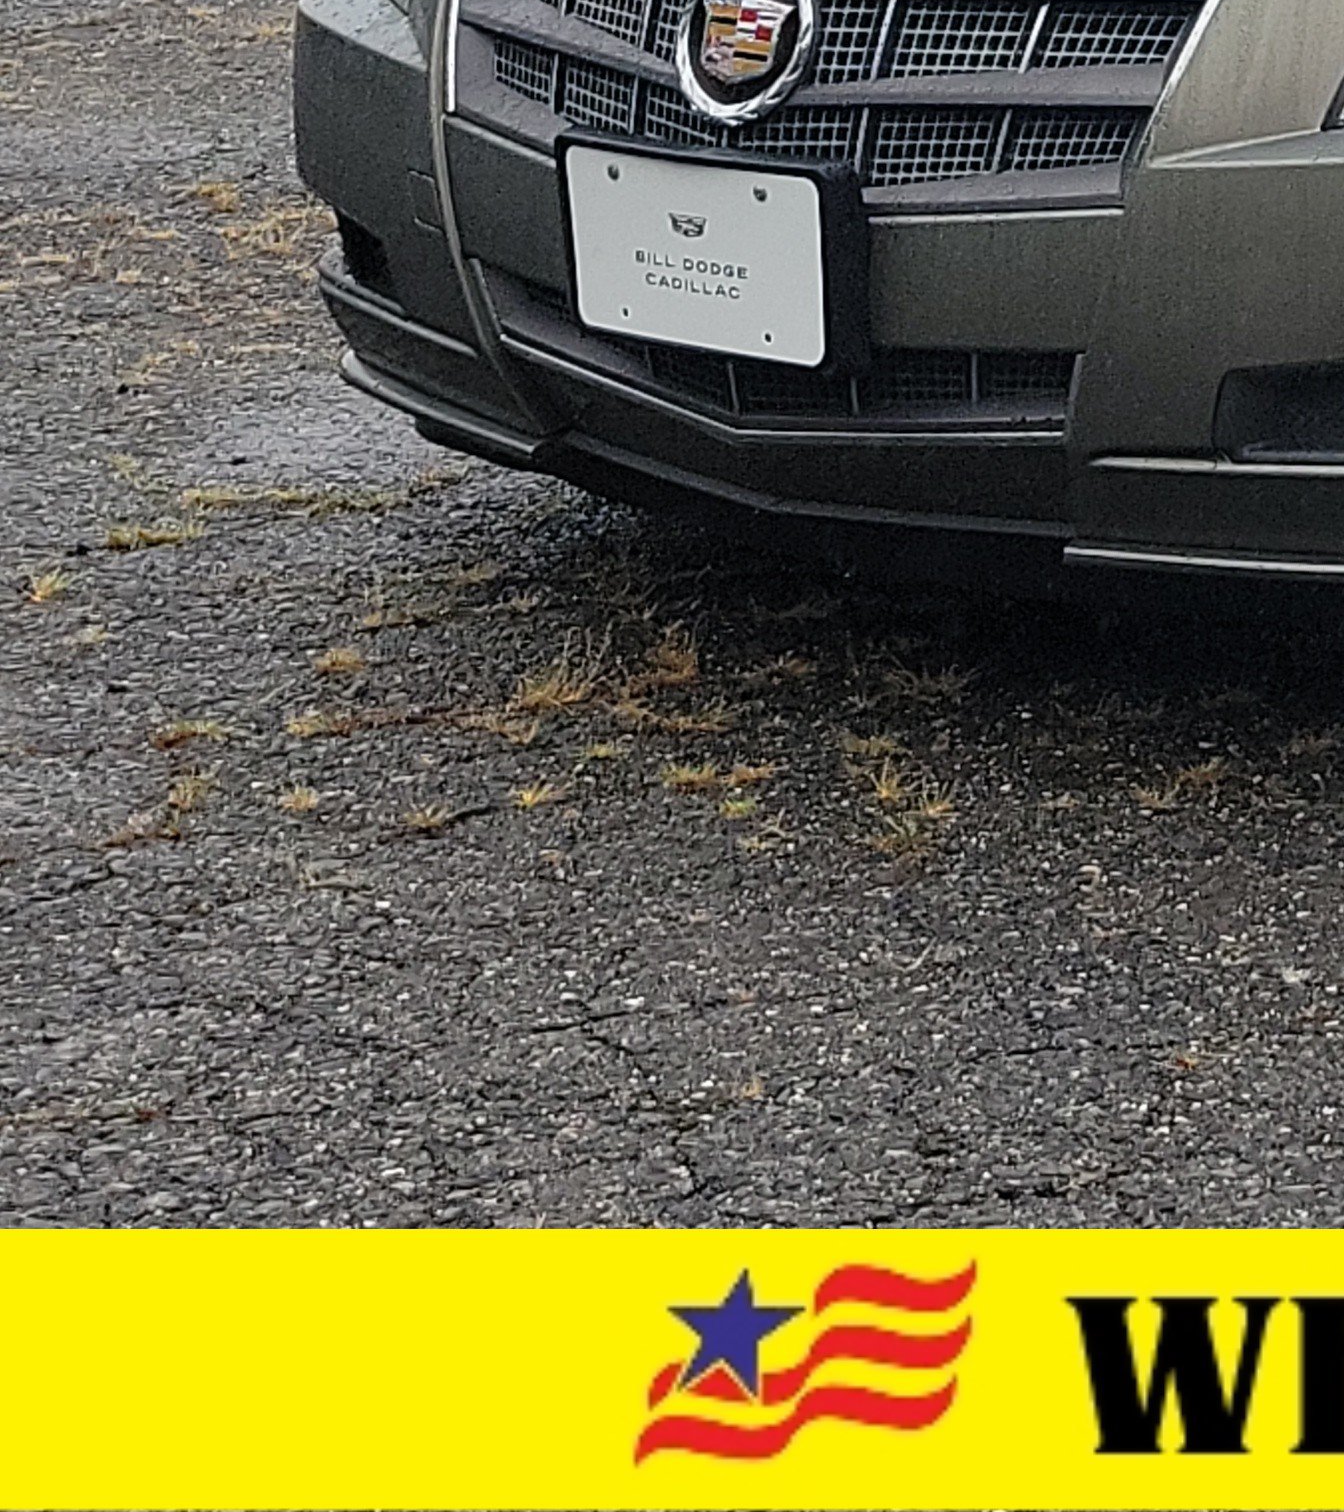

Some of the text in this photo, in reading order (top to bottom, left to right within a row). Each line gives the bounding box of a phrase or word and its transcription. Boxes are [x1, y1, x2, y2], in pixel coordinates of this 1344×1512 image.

[635, 250, 749, 280] BILL DODGE
[645, 271, 741, 300] CADILLAC
